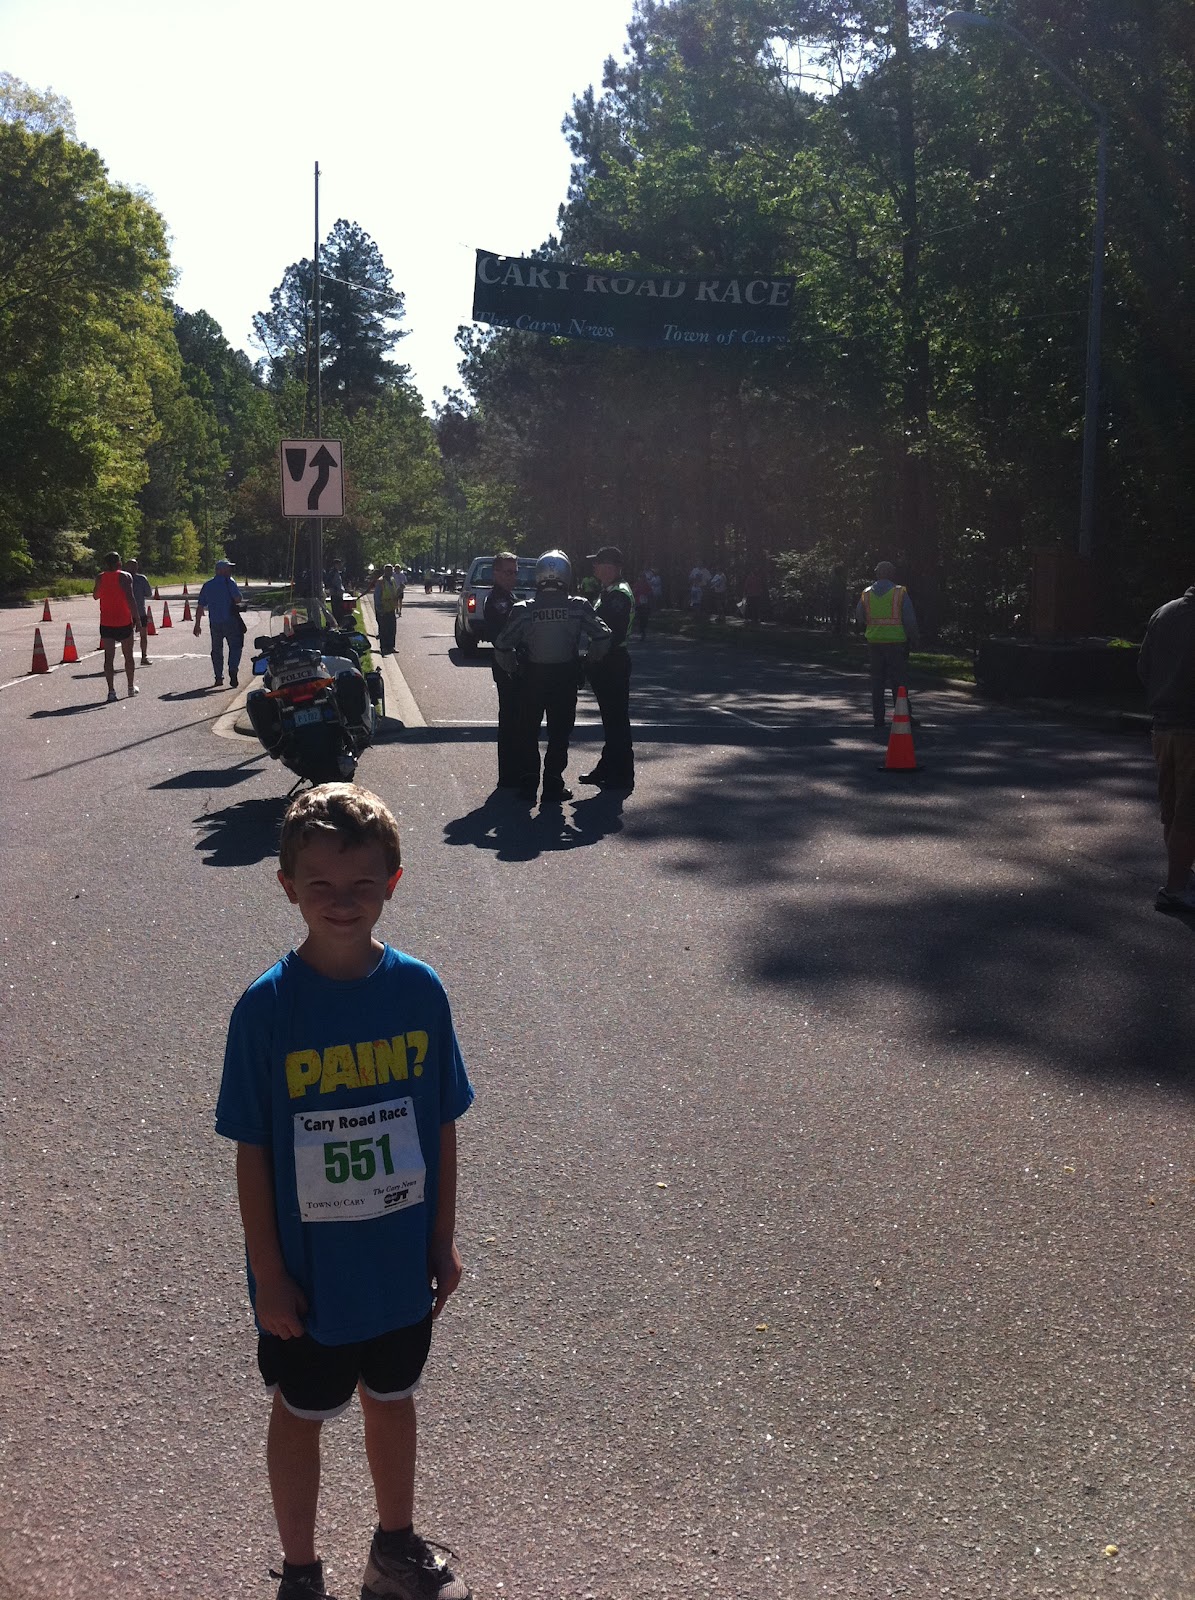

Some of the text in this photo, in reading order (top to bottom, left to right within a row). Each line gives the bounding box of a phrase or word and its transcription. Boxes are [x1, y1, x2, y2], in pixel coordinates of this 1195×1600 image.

[477, 256, 792, 307] CARY ROAD RACE
[475, 311, 509, 327] The
[515, 314, 560, 335] Cary
[663, 323, 710, 343] Town
[715, 329, 737, 346] of
[531, 608, 569, 622] POLICE
[280, 669, 314, 684] POLICE
[285, 1030, 429, 1099] PAIN?
[304, 1107, 408, 1132] Cary Road Race
[323, 1133, 395, 1184] 551
[373, 1187, 385, 1196] The
[385, 1184, 401, 1193] Cary
